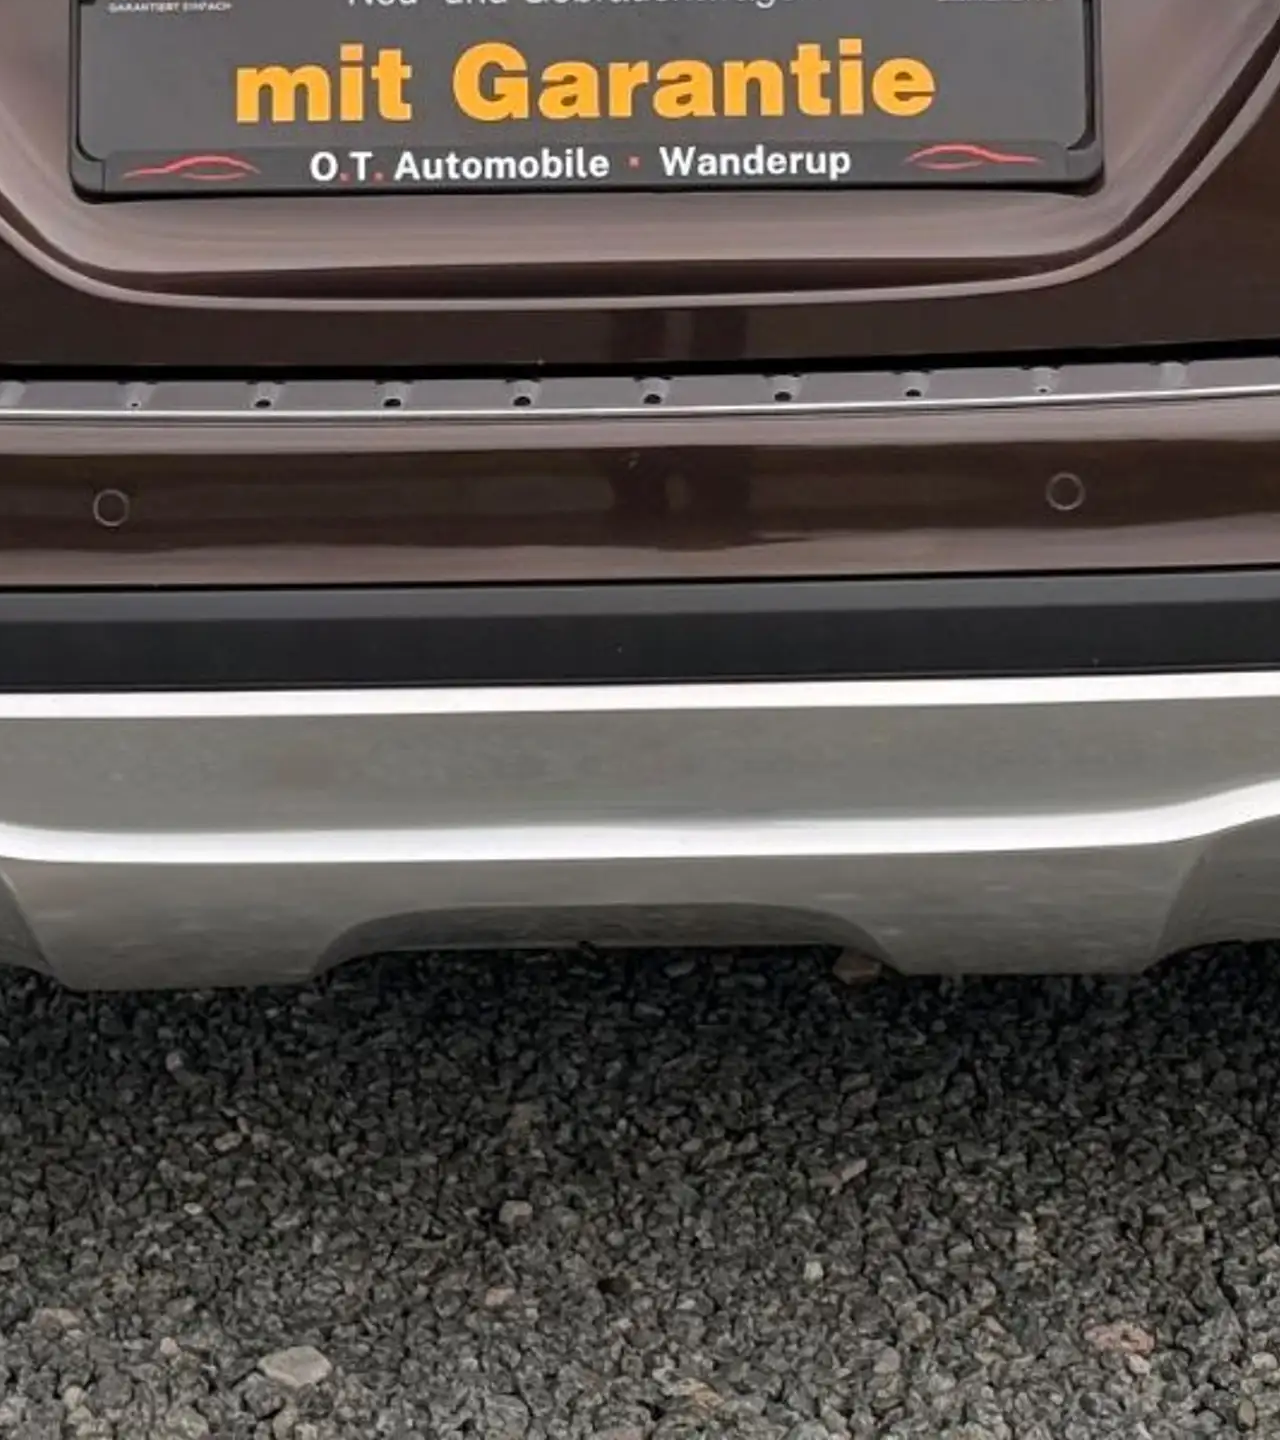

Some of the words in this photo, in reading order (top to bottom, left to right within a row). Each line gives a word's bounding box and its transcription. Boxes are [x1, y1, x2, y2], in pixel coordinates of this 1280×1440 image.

[236, 43, 413, 123] mit
[453, 38, 936, 121] Garantie
[310, 151, 385, 182] O.T.
[394, 146, 610, 181] Automobile
[660, 145, 852, 181] Wanderup
